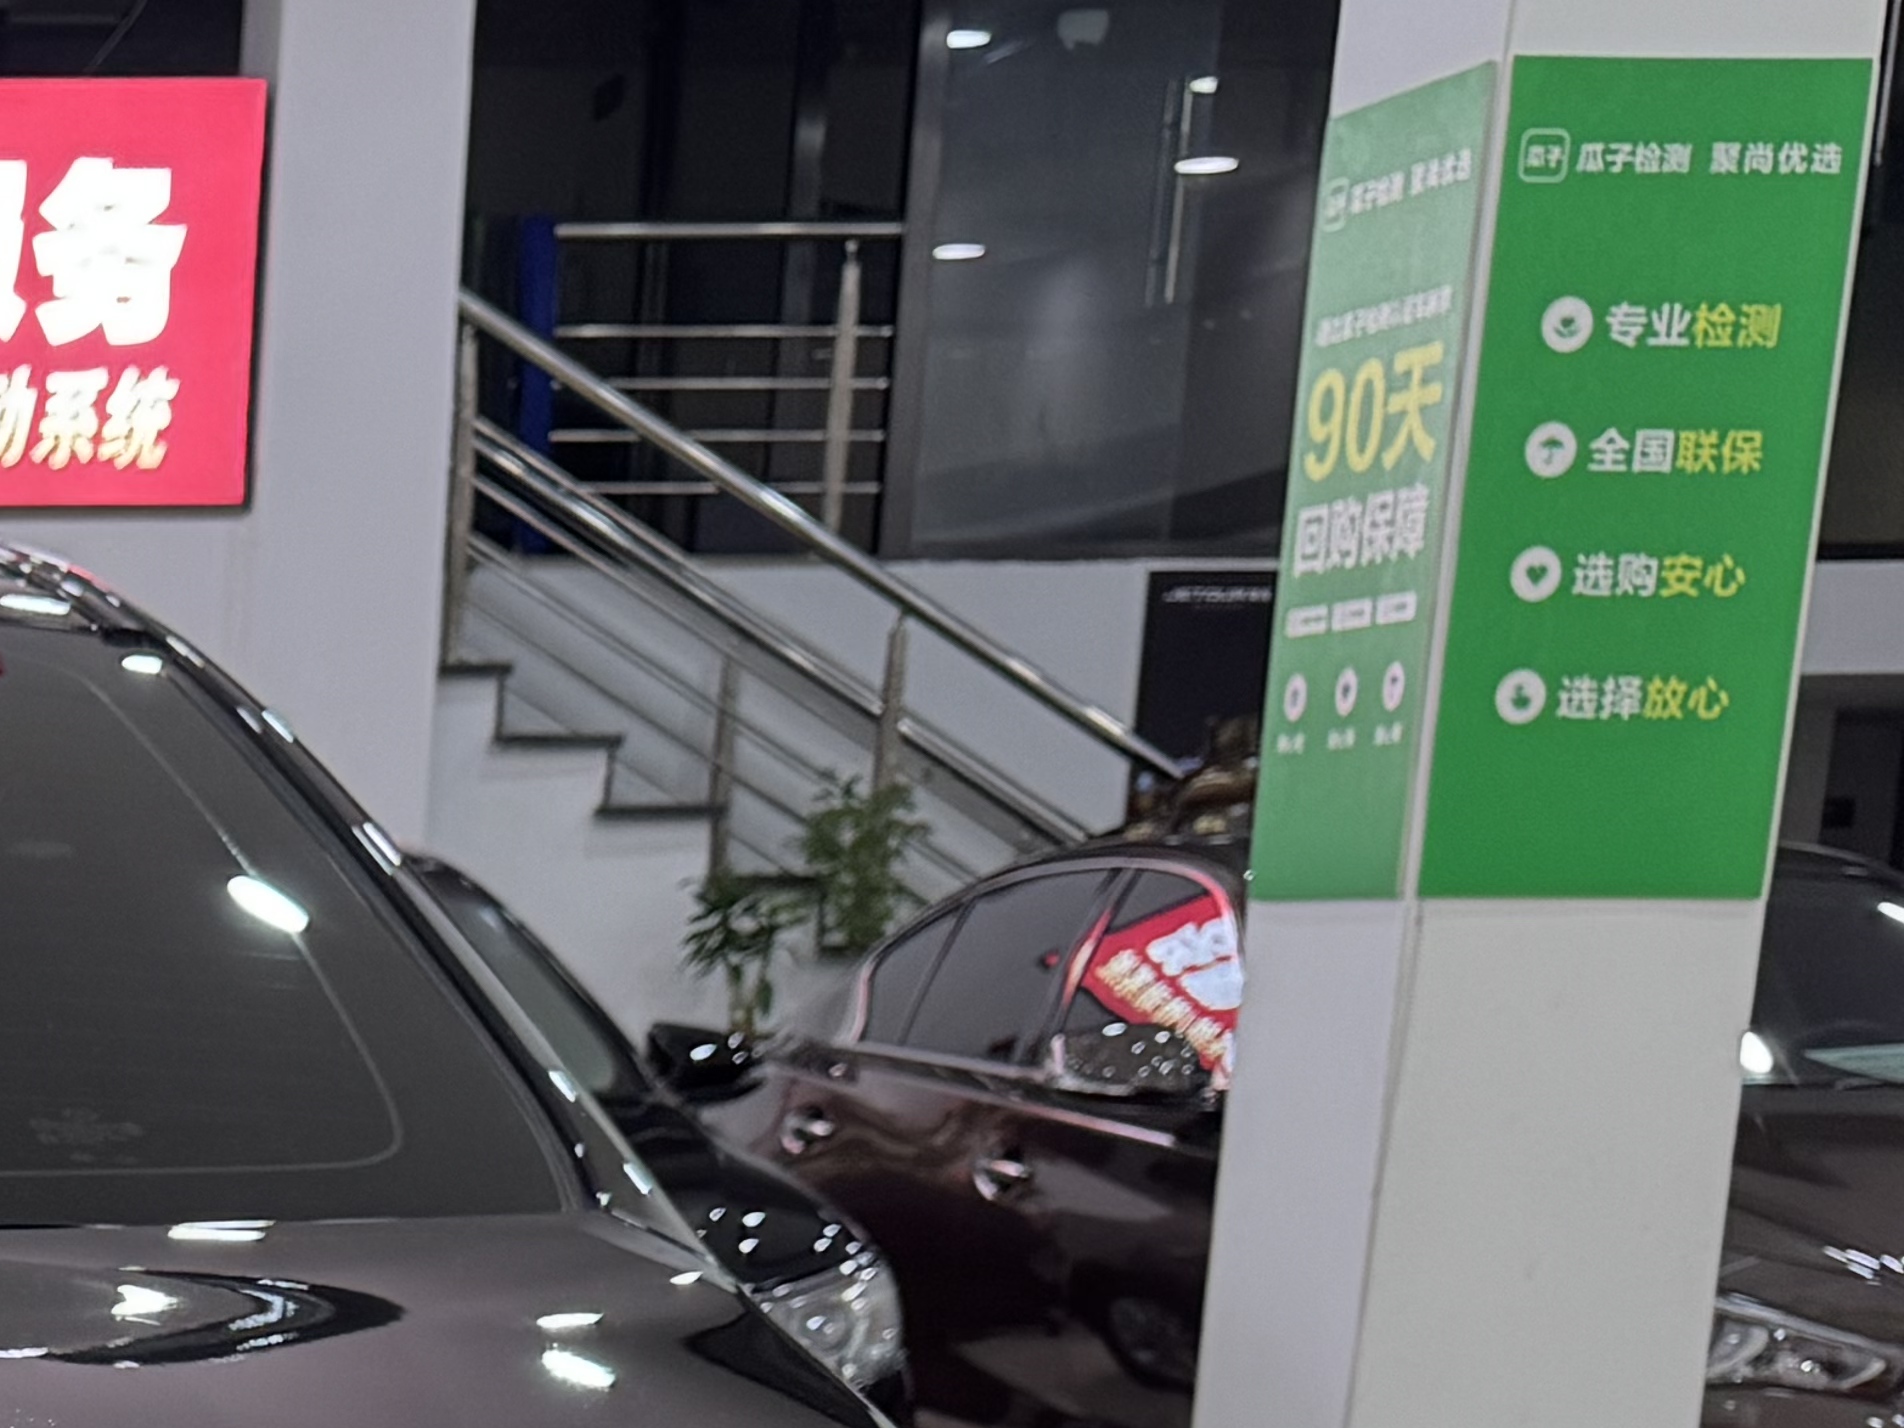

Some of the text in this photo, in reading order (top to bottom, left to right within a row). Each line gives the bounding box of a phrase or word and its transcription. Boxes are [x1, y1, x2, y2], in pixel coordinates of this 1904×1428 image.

[1576, 141, 1843, 174] 瓜子检测 聚尚优选
[1605, 301, 1782, 350] 专业检测
[1303, 340, 1445, 483] 90天
[1587, 426, 1764, 475] 全国联保
[1293, 482, 1430, 579] 回购保障
[1571, 551, 1746, 599] 选购安心
[1555, 674, 1730, 722] 选择放心
